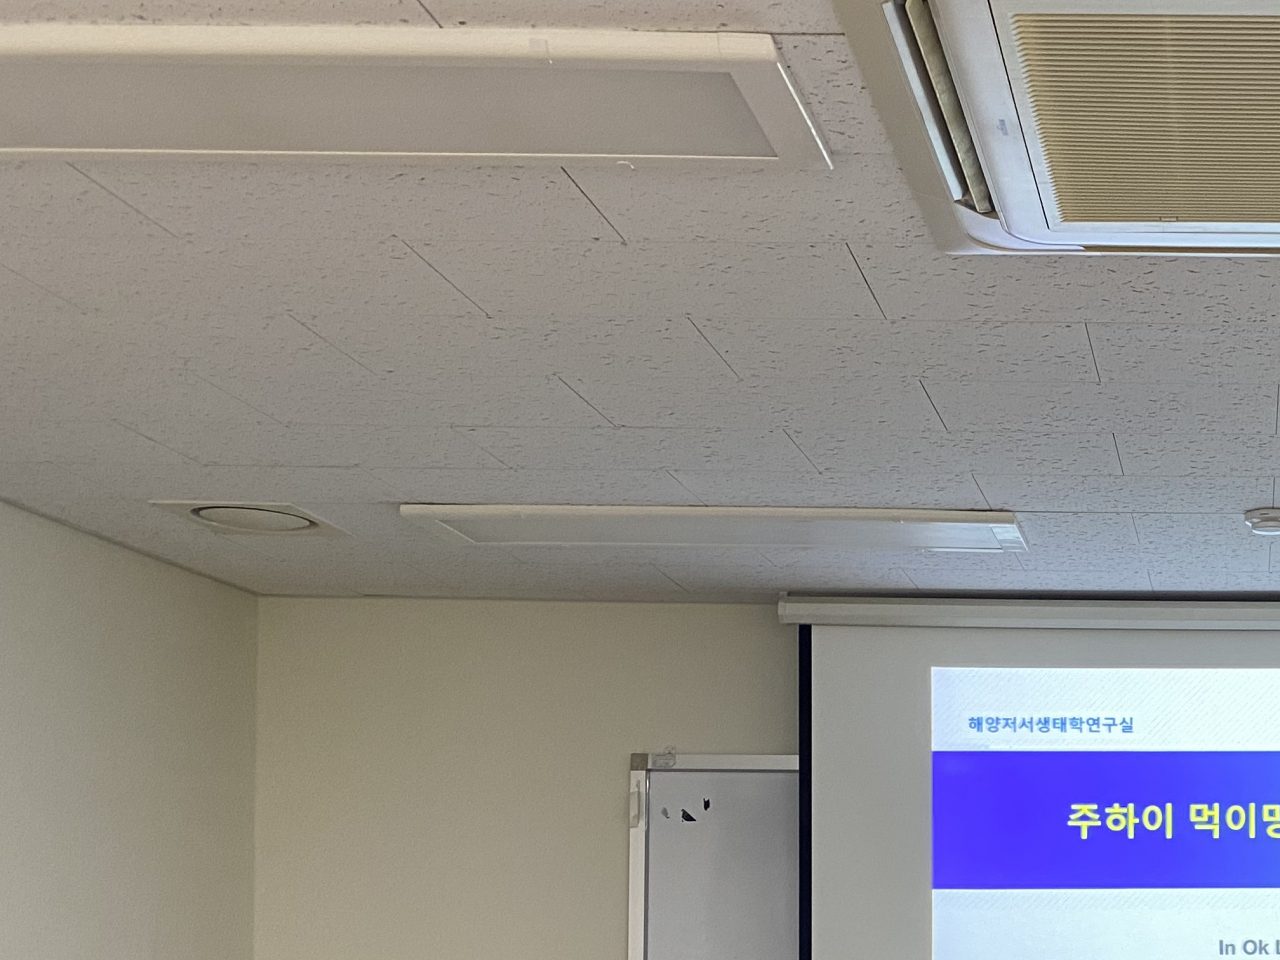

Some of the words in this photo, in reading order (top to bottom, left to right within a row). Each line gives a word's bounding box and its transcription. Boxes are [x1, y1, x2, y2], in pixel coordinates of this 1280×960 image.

[968, 715, 1134, 734] 해양저서생태학연구실
[1067, 802, 1174, 839] 주하이
[1218, 940, 1237, 955] In
[1242, 939, 1269, 956] Ok
